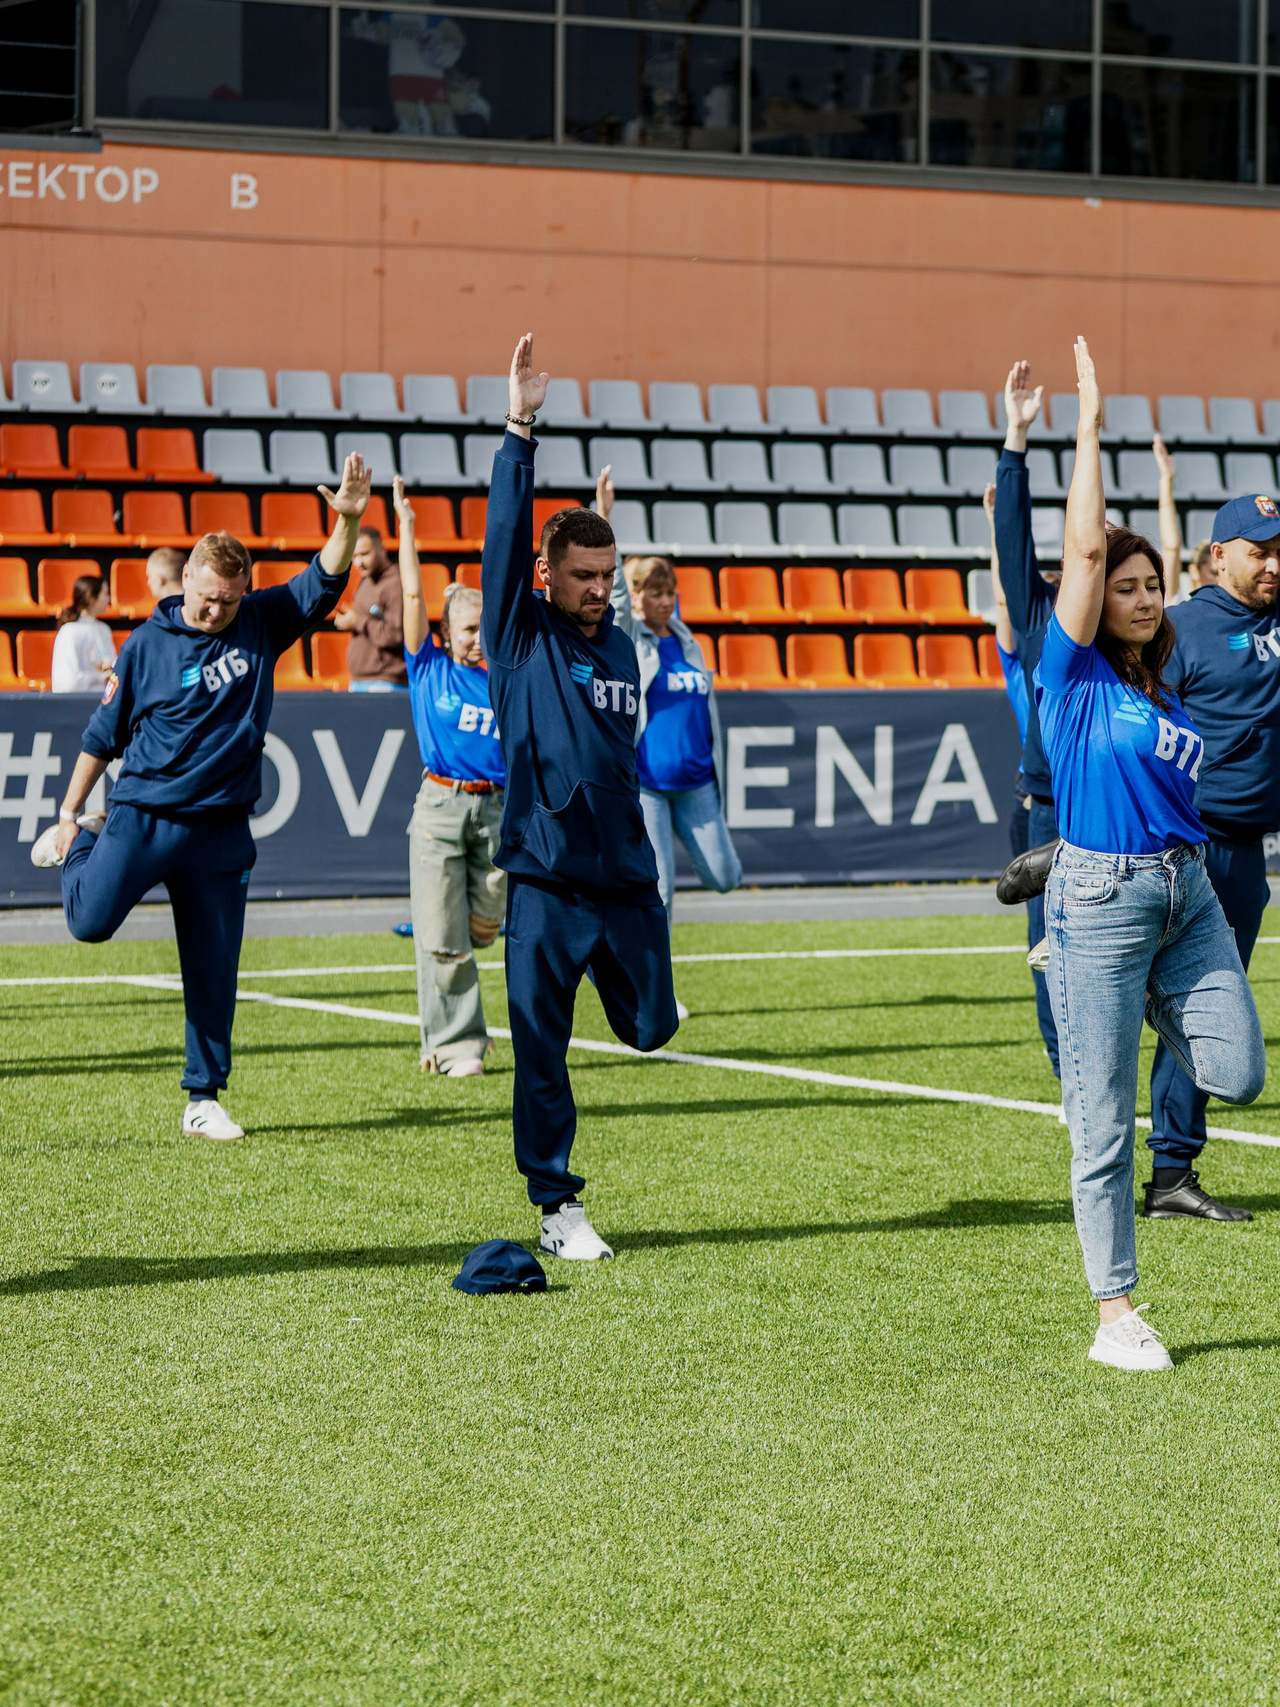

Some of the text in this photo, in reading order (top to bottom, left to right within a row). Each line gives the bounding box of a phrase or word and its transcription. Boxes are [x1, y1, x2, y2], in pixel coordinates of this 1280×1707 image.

[0, 161, 259, 209] ЕКТОР В
[201, 648, 249, 693] ВТБ
[667, 671, 708, 695] ВТБ
[593, 677, 637, 716] ВТБ
[458, 702, 500, 740] ВТ
